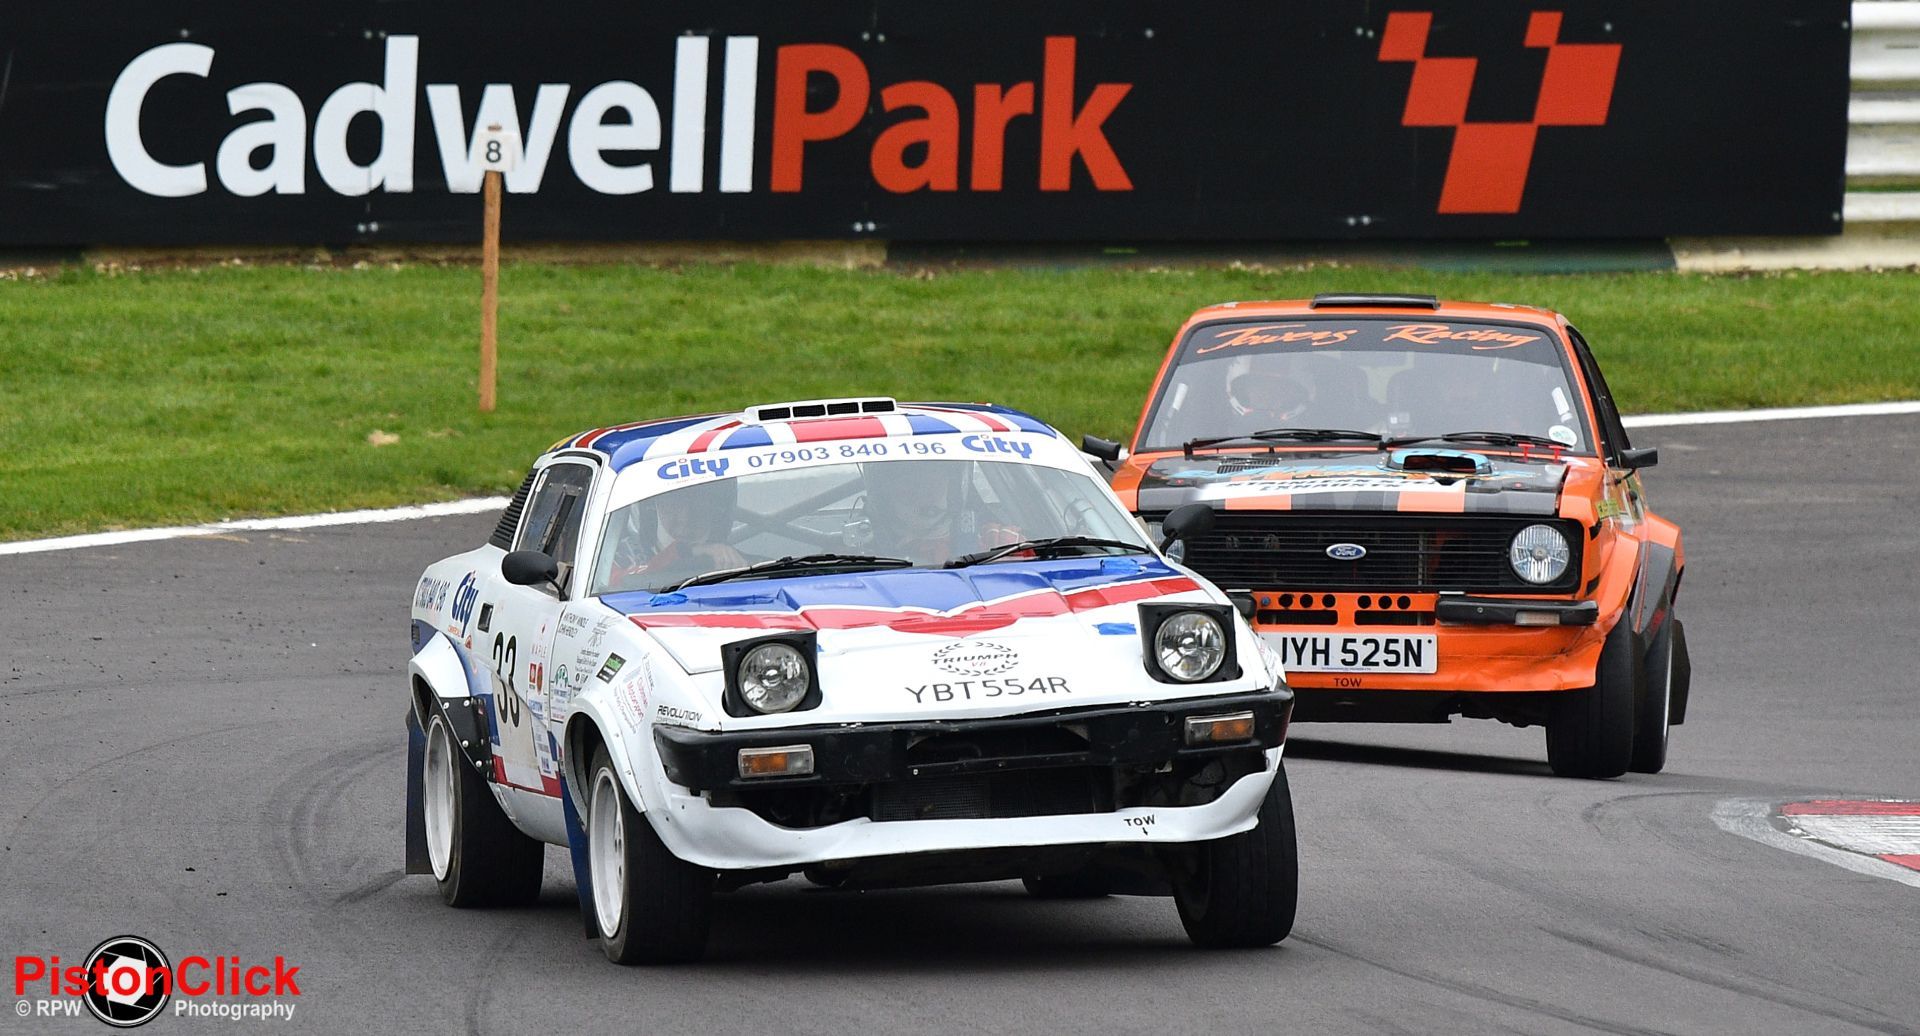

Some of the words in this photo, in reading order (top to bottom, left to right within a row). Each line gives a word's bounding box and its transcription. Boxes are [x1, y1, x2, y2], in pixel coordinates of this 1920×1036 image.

[486, 140, 502, 163] 8
[1383, 324, 1542, 350] Racing
[657, 457, 730, 480] City
[747, 446, 830, 468] 07903
[839, 441, 888, 458] 840
[898, 442, 947, 455] 196
[961, 433, 1033, 459] City
[1335, 546, 1357, 556] Ford
[452, 570, 479, 639] City
[931, 652, 1018, 665] TRIUMPH
[1281, 636, 1331, 667] JYH
[1340, 637, 1422, 668] 525N
[493, 631, 520, 728] 33
[1333, 677, 1362, 687] TOW
[657, 704, 703, 722] REVOLUTION
[1123, 814, 1155, 827] TOW
